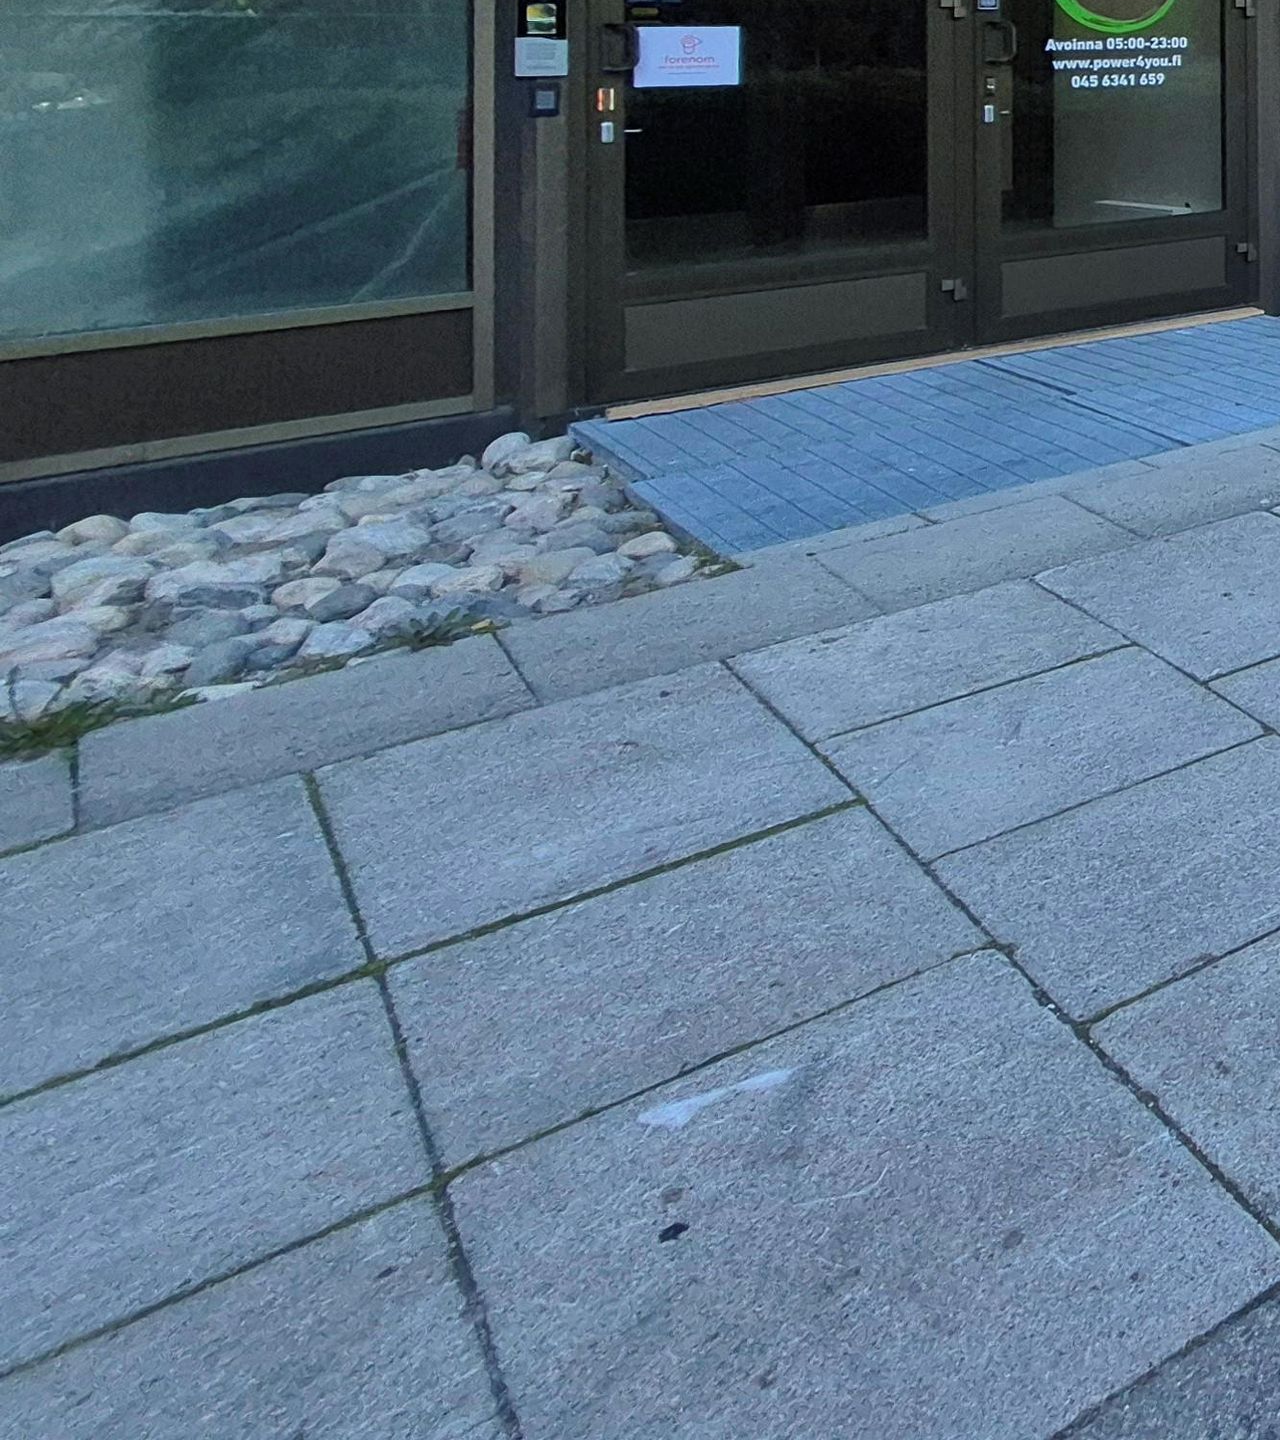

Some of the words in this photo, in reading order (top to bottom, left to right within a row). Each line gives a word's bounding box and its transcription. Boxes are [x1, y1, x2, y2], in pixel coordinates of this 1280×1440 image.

[1045, 38, 1103, 51] Avoinna
[1106, 37, 1188, 50] 05:00-23:00
[1052, 55, 1182, 71] www.power4you.fi
[1070, 75, 1099, 88] 045
[1102, 74, 1135, 87] 6341
[1139, 73, 1165, 86] 659
